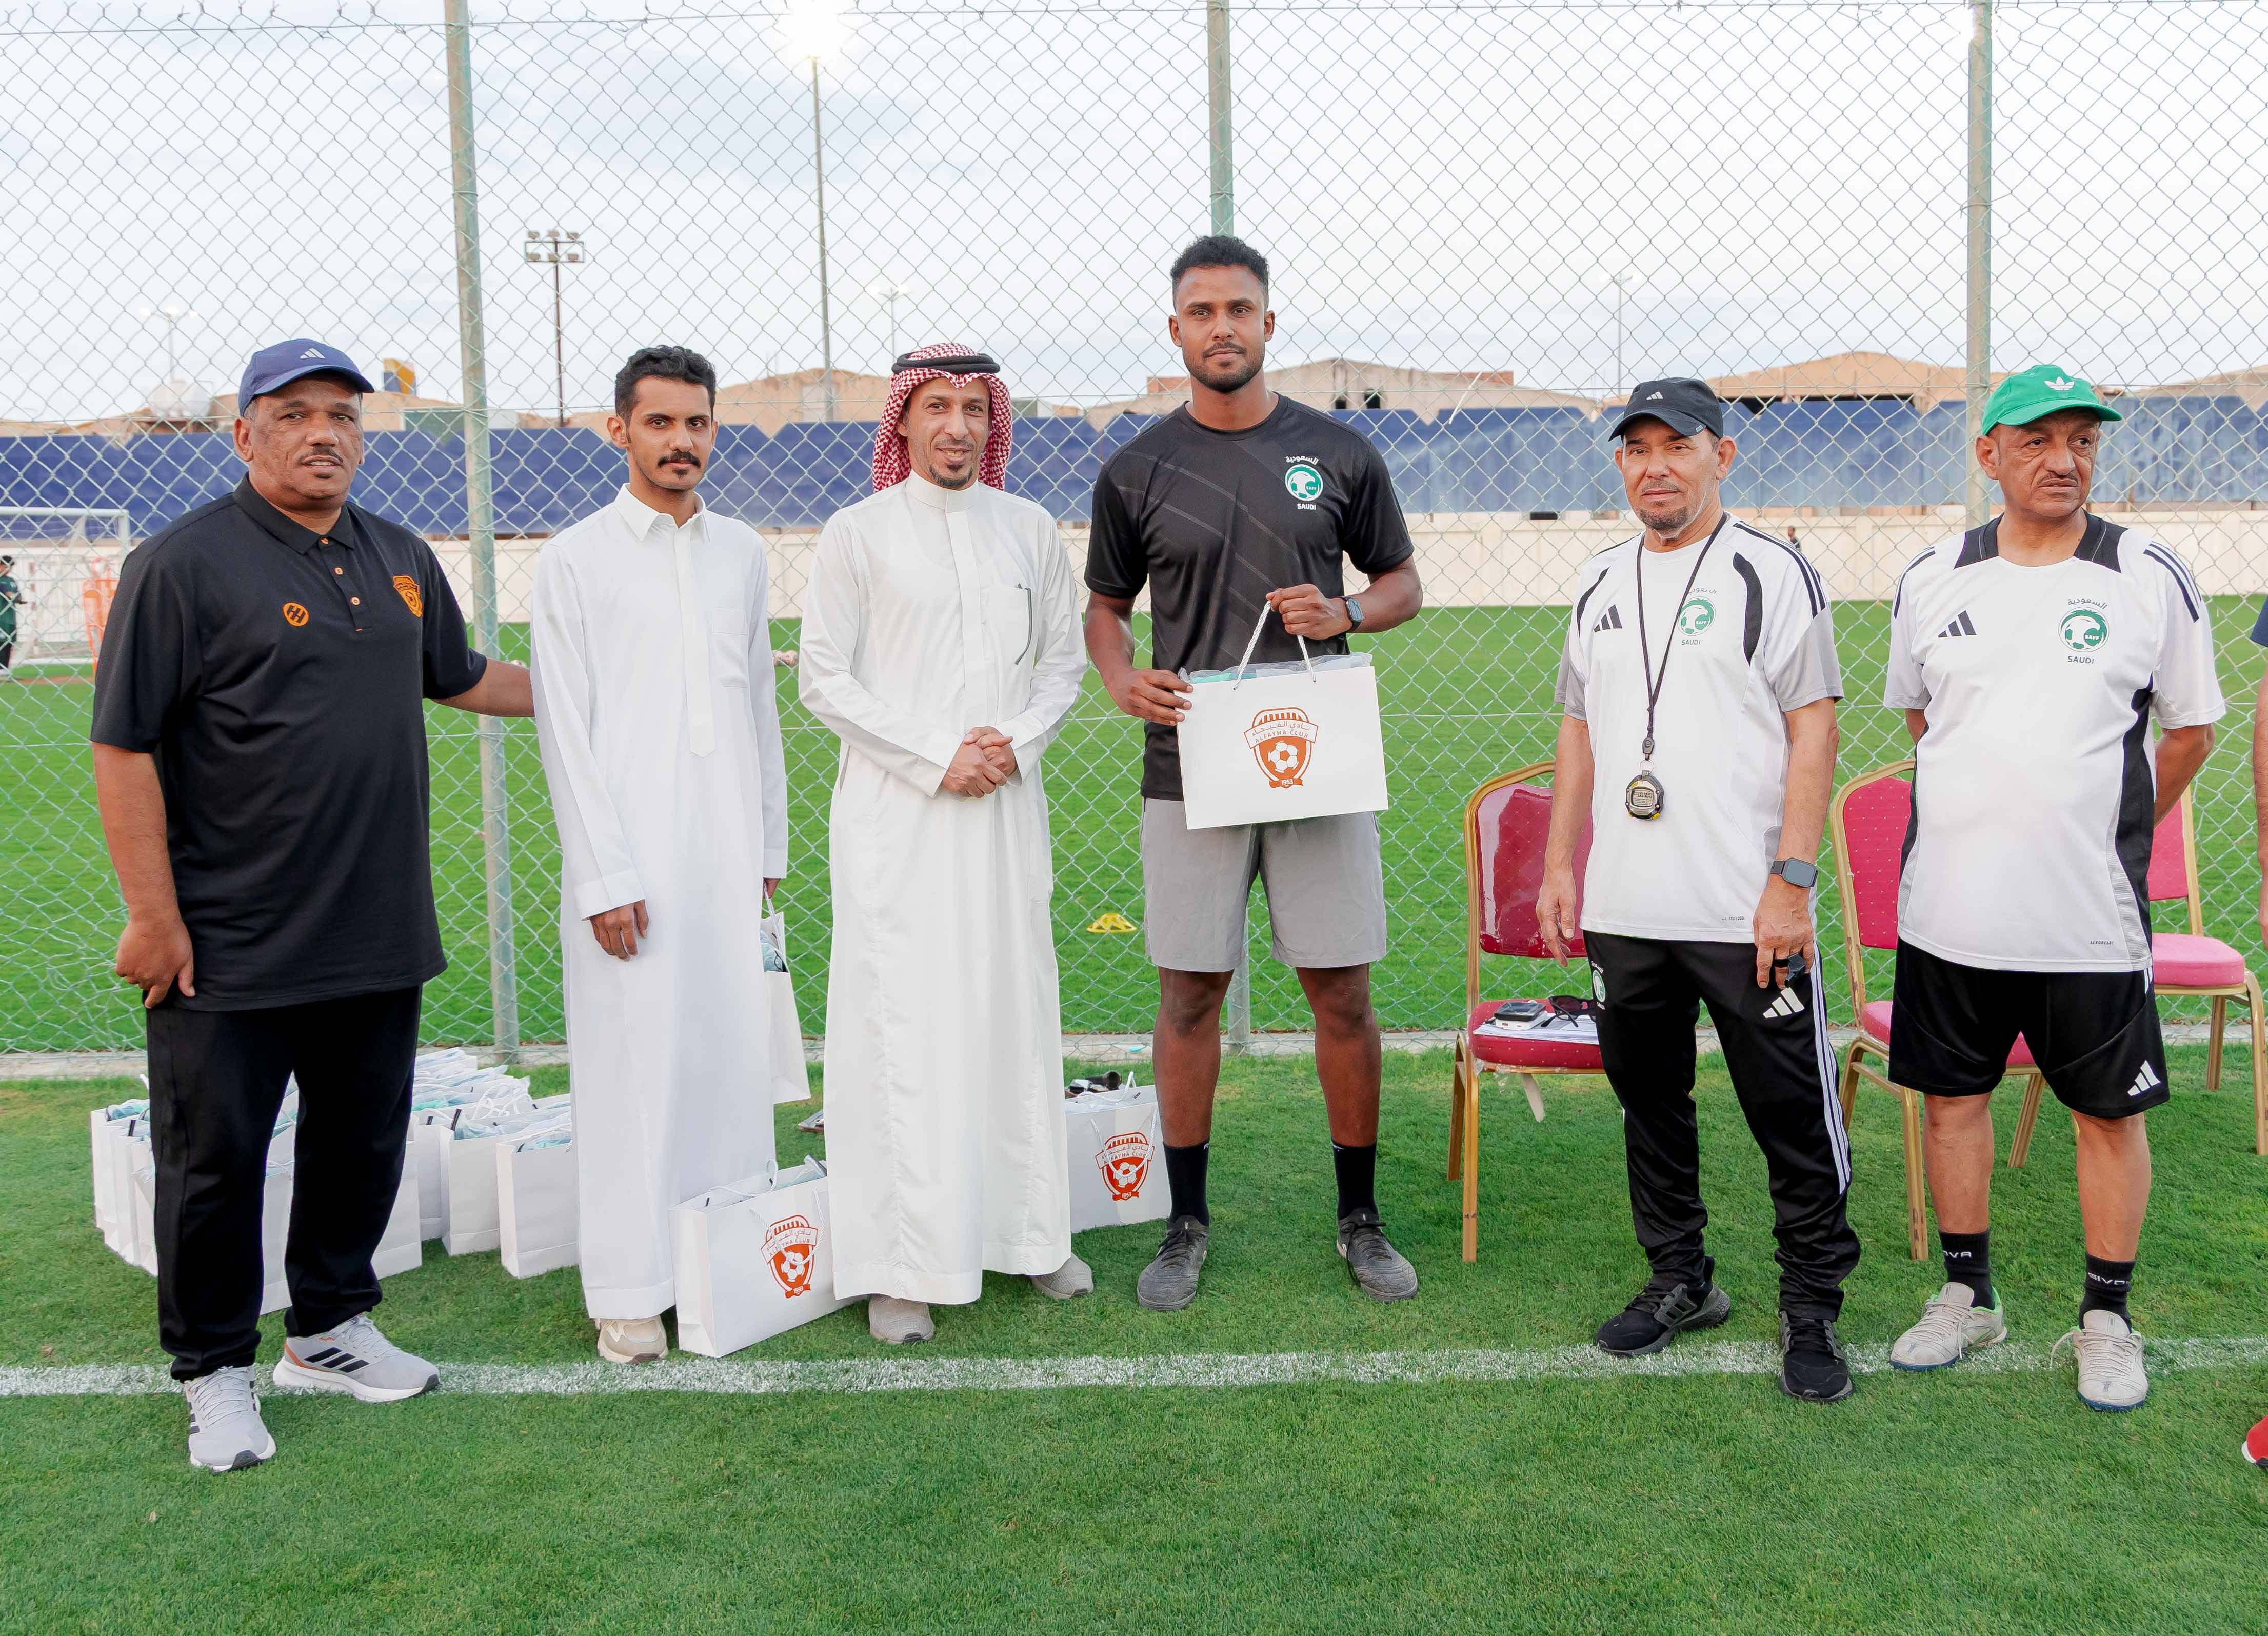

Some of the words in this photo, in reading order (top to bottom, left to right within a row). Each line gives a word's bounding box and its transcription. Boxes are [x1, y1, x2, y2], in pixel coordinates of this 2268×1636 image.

[1285, 455, 1319, 465] السعودية
[2067, 598, 2108, 609] السعودية
[2067, 655, 2094, 664] SAUDI
[1255, 730, 1287, 743] ALFAYHA
[1289, 730, 1308, 739] CLUB
[1103, 1152, 1130, 1164] AFAYHA
[2088, 1272, 2129, 1286] GIVO
